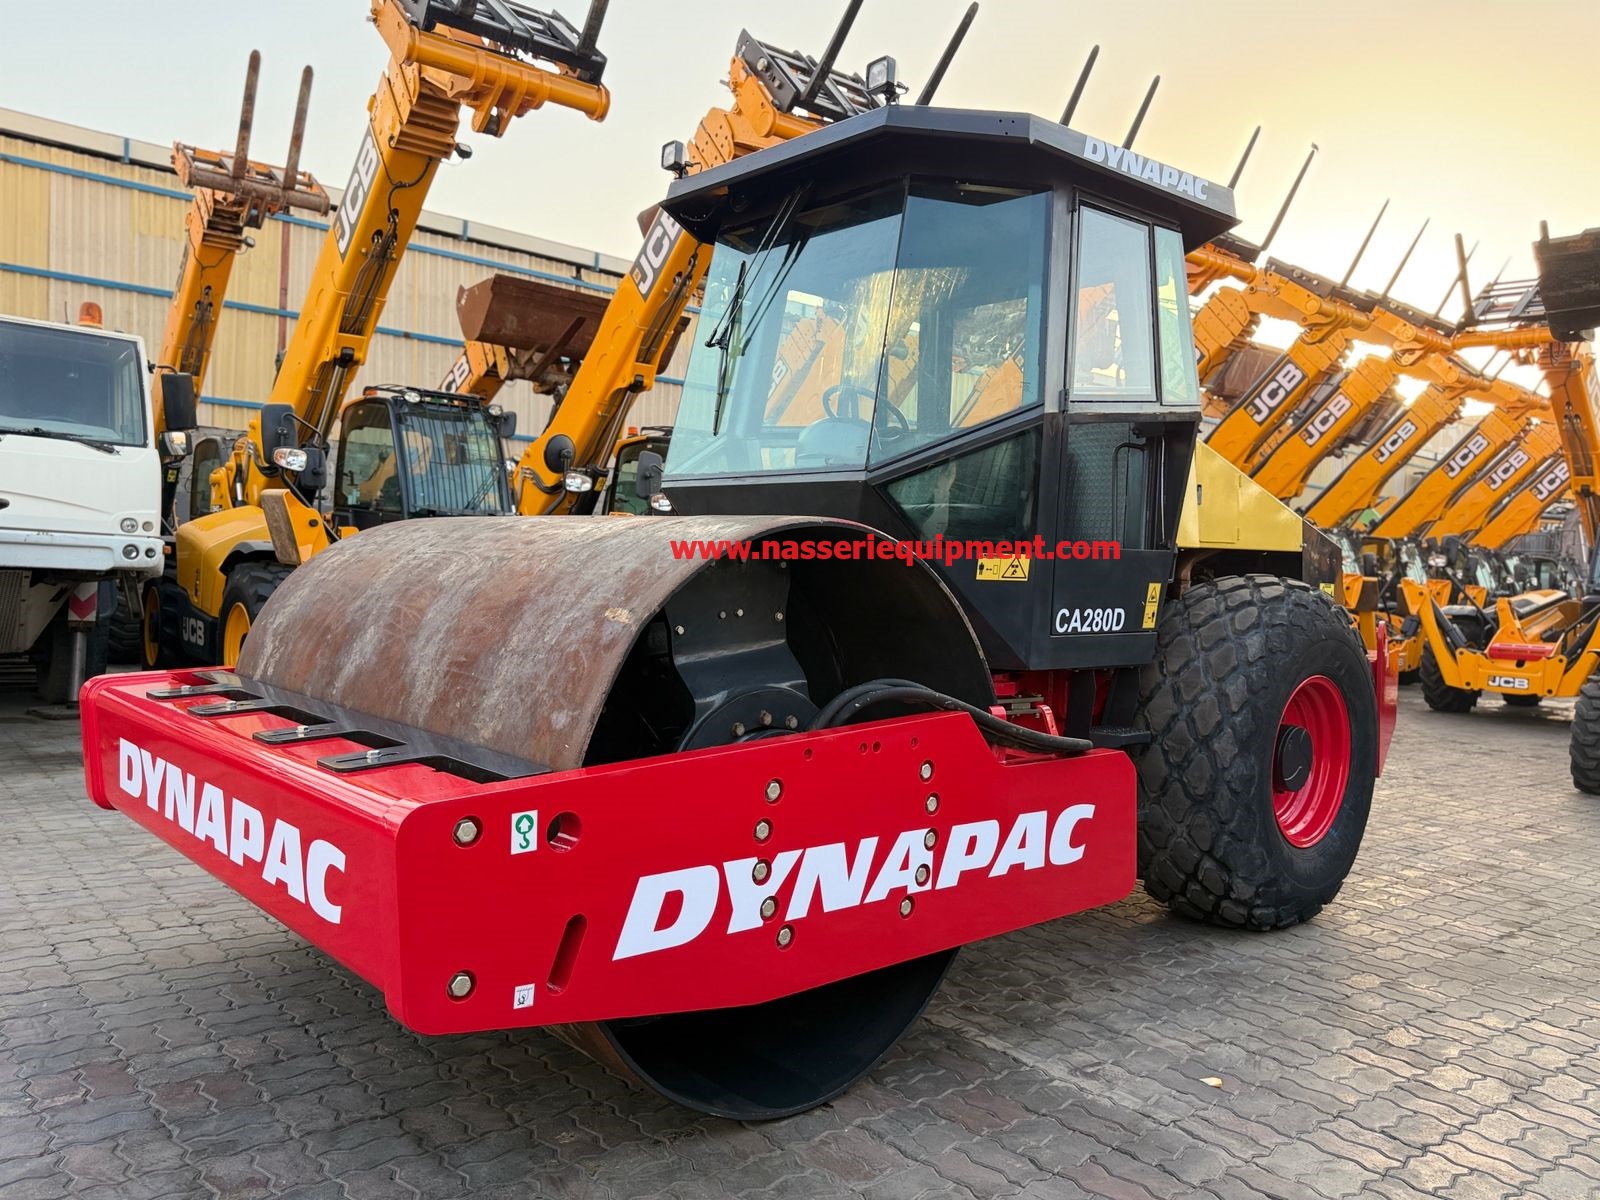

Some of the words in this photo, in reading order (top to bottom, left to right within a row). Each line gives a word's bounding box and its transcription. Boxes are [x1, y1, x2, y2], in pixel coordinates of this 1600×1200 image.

[1083, 135, 1209, 201] DYNAPAC
[338, 135, 378, 254] JCB
[441, 354, 470, 393] CB
[1251, 363, 1304, 423] JCB
[1304, 394, 1352, 446] JCB
[1377, 420, 1417, 463] JCB
[1446, 435, 1489, 478] JCB
[1489, 450, 1529, 490] JCB
[182, 616, 205, 646] JCB
[1055, 608, 1126, 633] CA280D
[1488, 676, 1529, 690] JCB
[119, 737, 346, 924] DYNAPAC
[612, 803, 1096, 962] DYNAPAC
